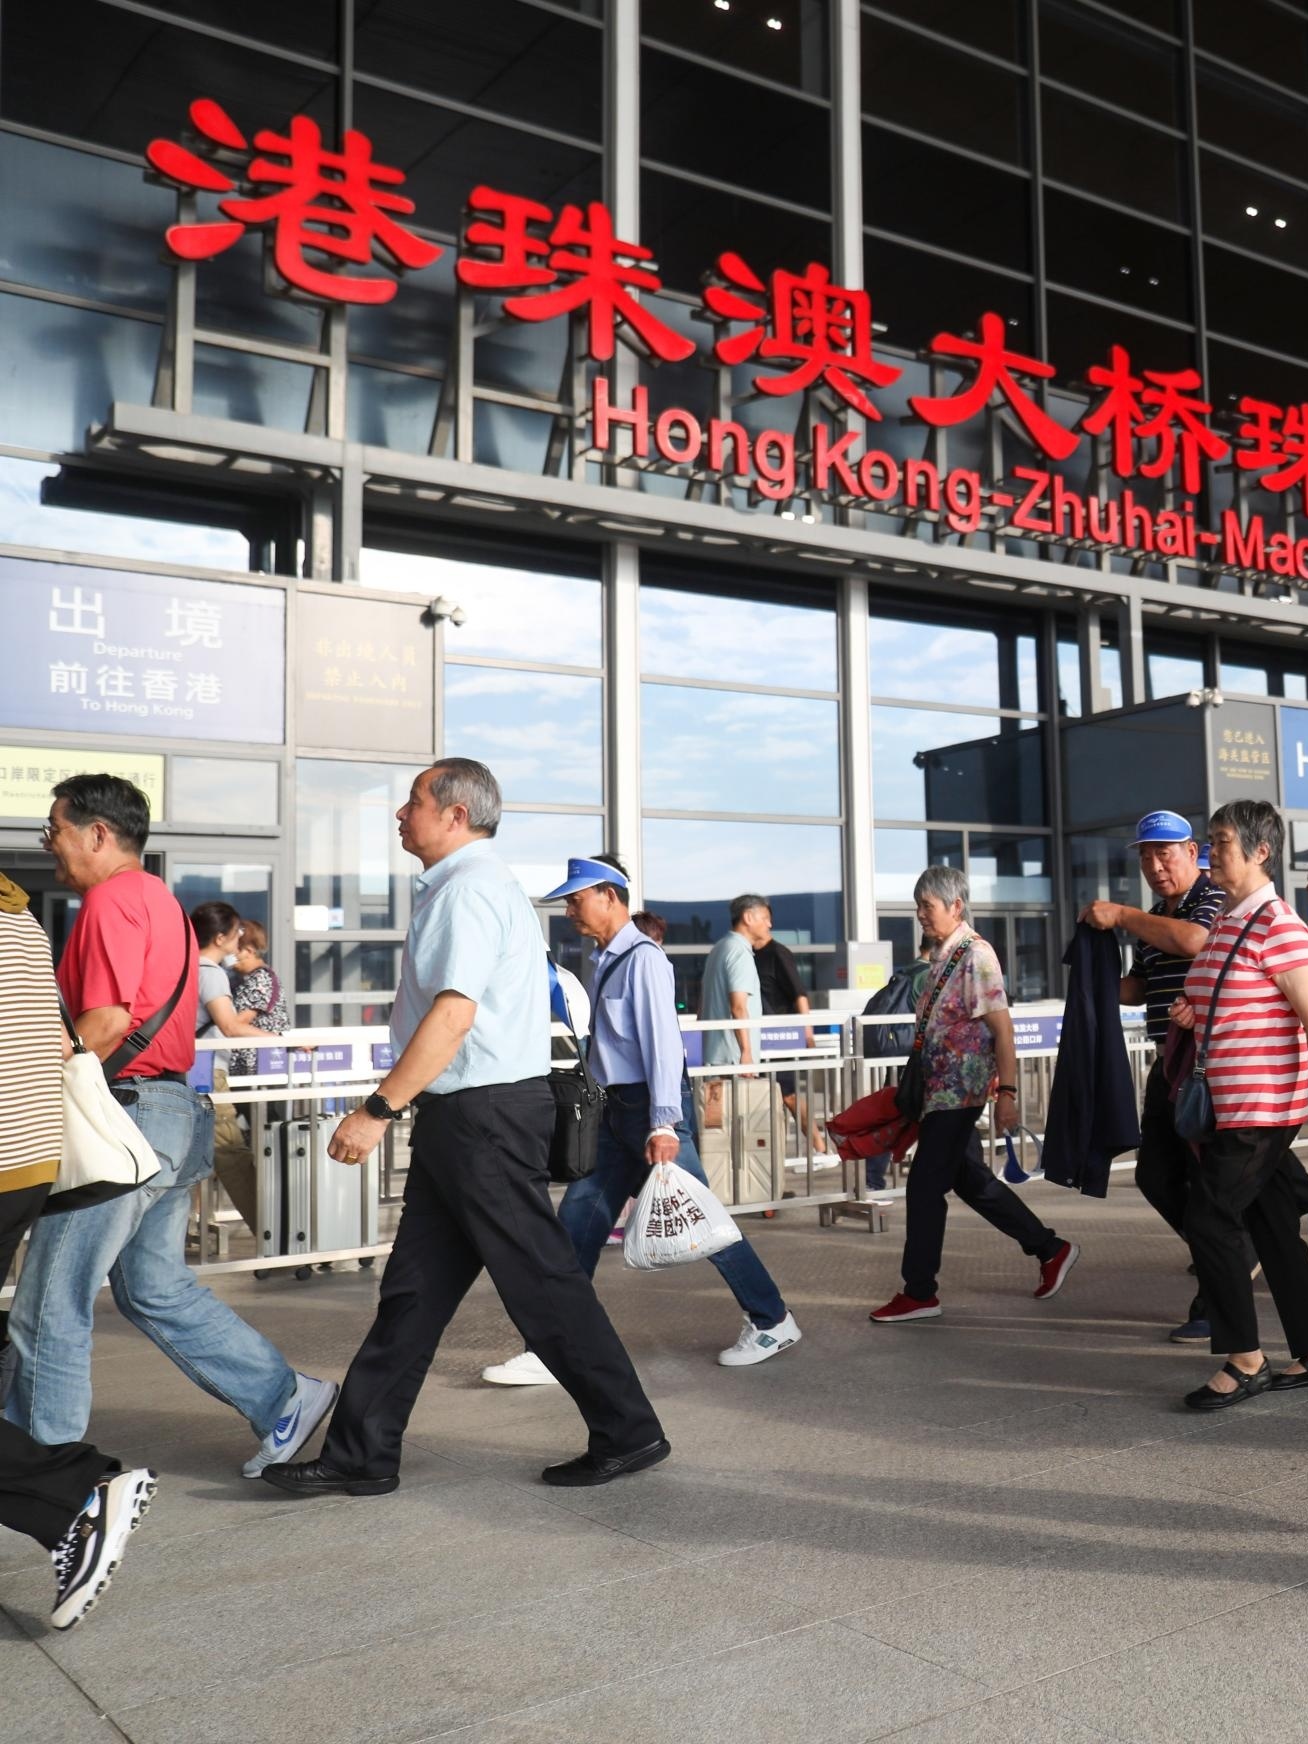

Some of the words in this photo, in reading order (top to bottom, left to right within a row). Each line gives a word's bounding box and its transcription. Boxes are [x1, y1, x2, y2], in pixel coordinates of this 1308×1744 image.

[593, 377, 796, 500] Hong
[93, 641, 185, 663] Departure
[48, 661, 224, 705] 前往香港
[81, 697, 102, 713] To
[104, 699, 150, 718] Hong
[152, 703, 195, 721] Kong
